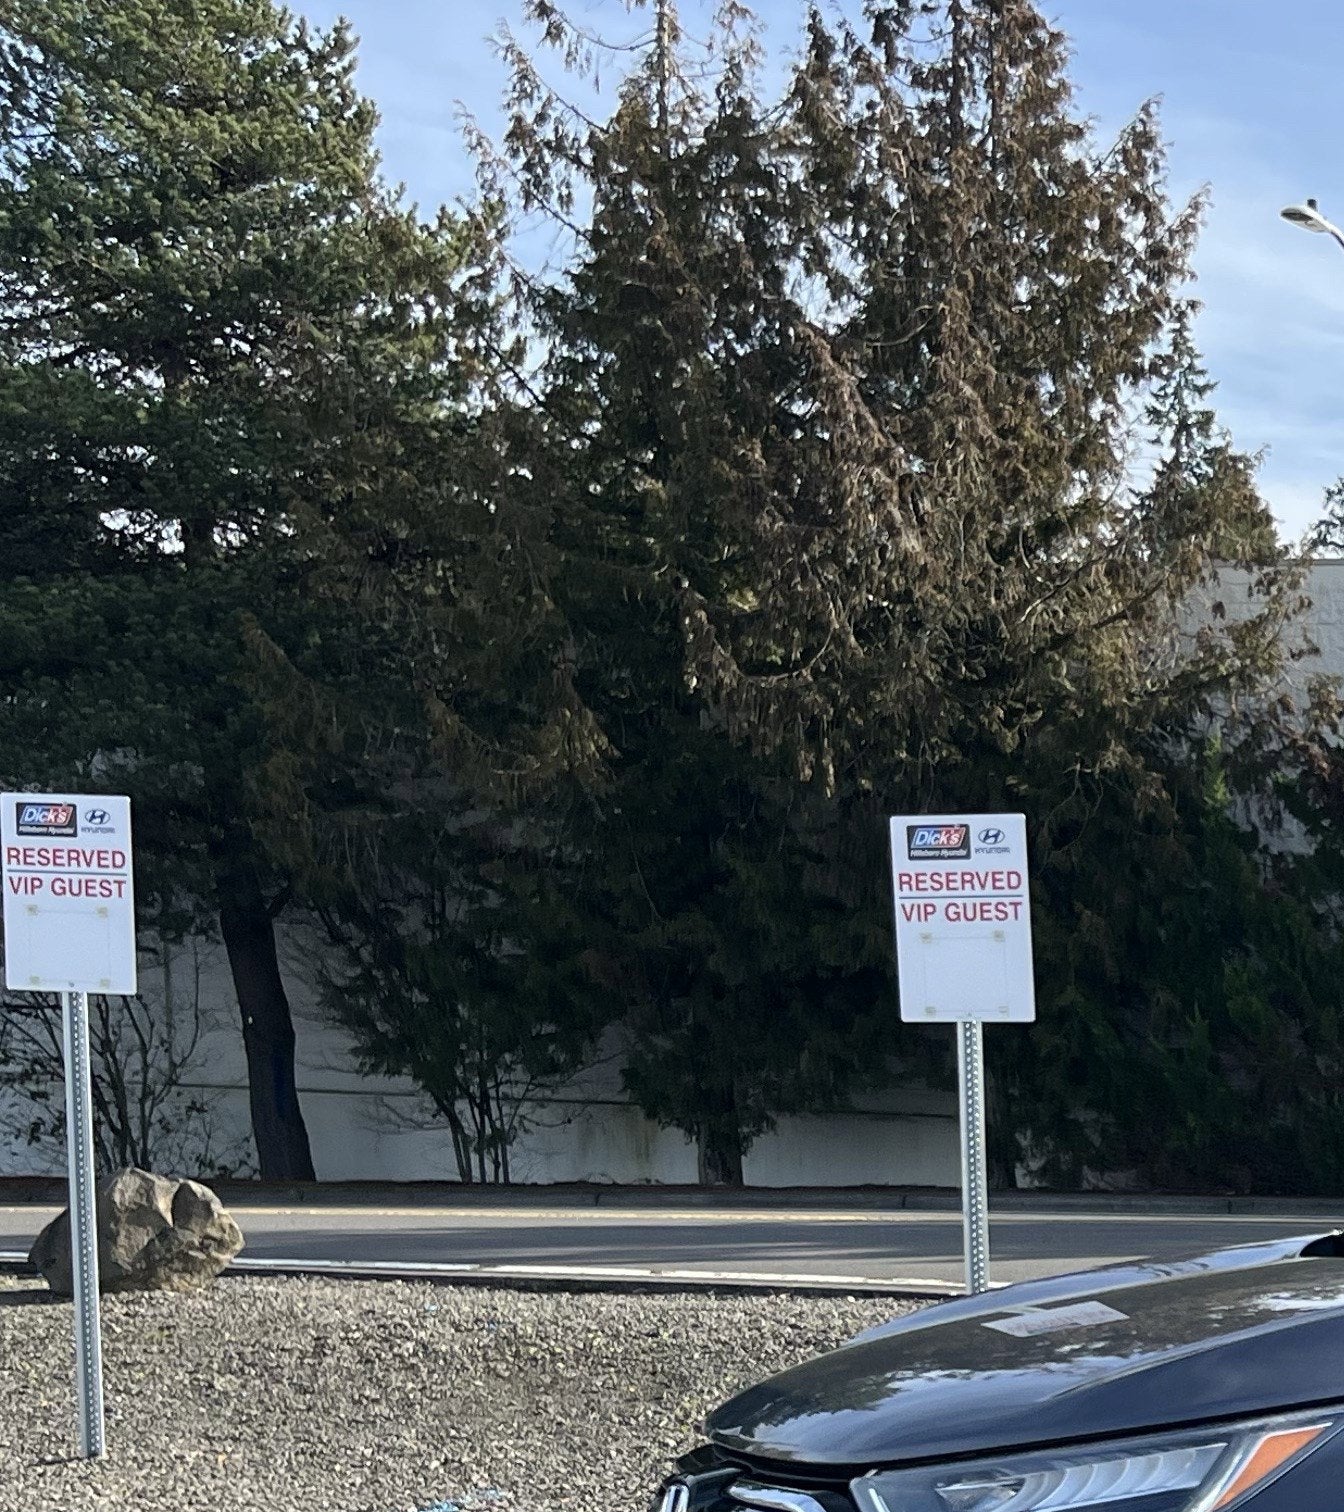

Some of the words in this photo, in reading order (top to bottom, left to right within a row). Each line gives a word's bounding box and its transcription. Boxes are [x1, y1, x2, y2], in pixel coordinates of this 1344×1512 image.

[6, 847, 126, 869] RESERVED
[8, 876, 43, 895] VIP
[51, 877, 126, 898] GUEST
[898, 871, 1022, 892] RESERVED
[901, 903, 937, 922] VIP
[944, 901, 1023, 922] GUEST
